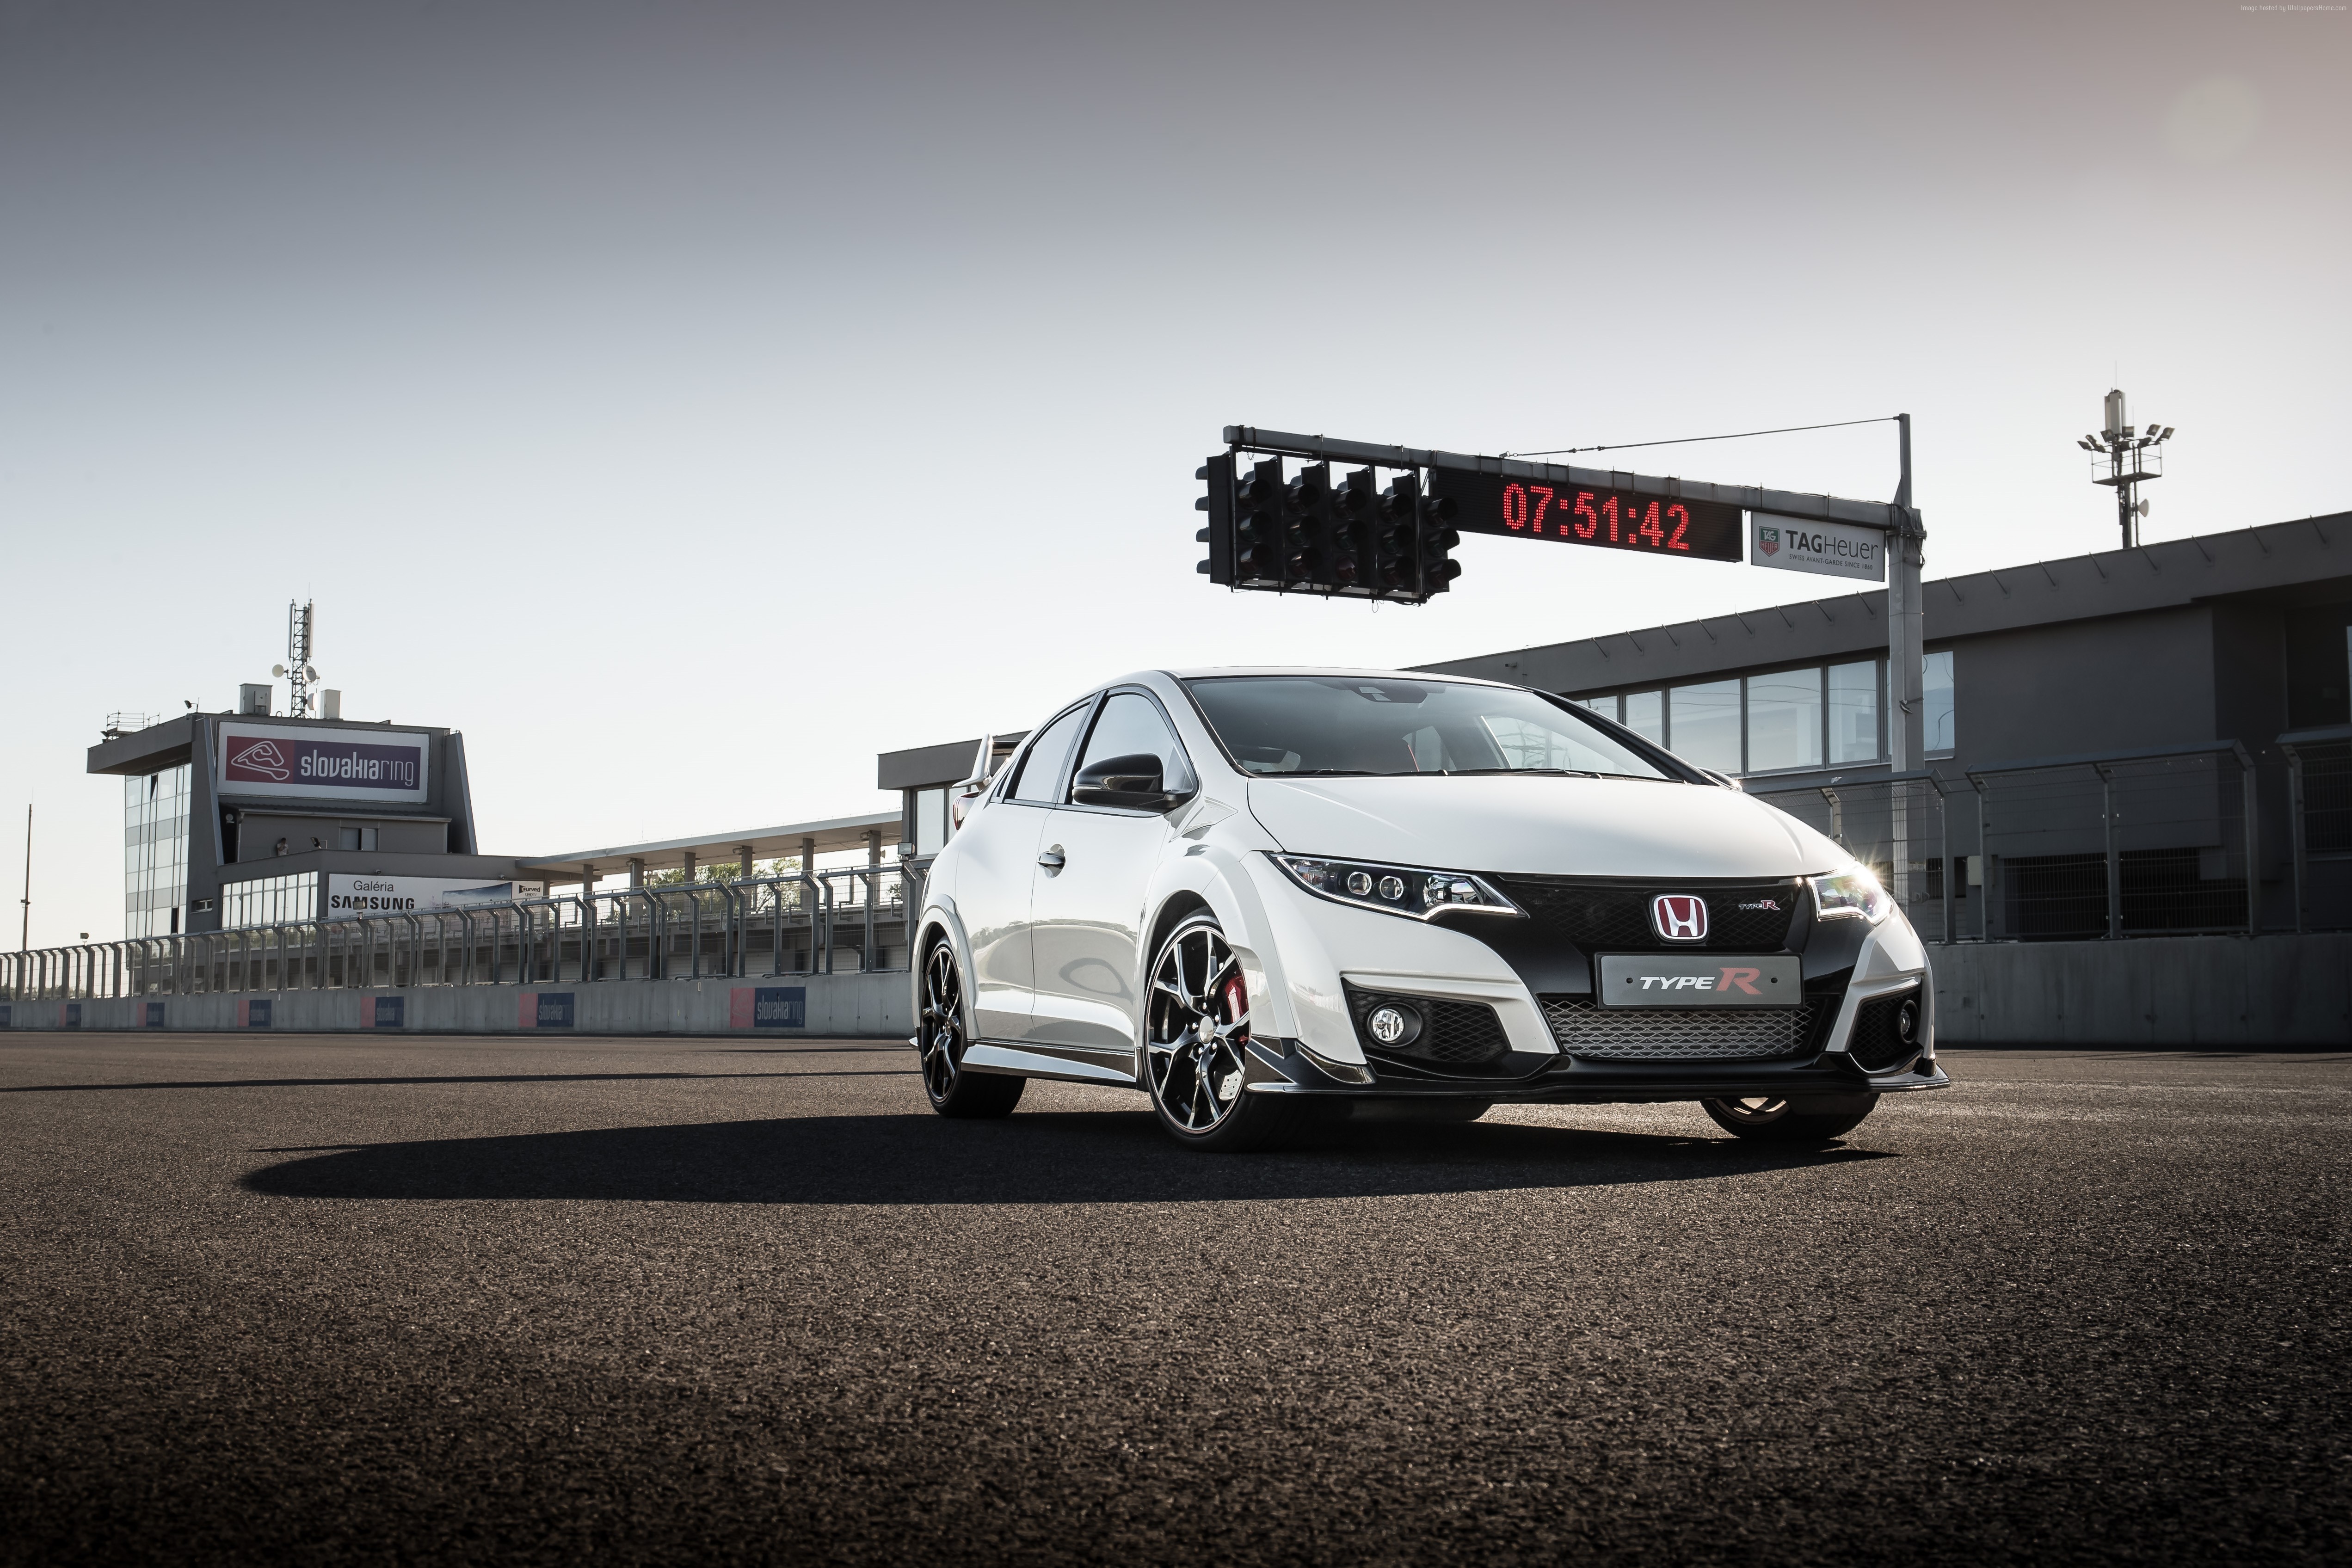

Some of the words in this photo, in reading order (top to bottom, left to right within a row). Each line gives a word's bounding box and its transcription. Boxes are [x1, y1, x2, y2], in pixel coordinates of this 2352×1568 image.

[1503, 483, 1689, 550] 07:51:42
[1763, 530, 1776, 541] TAG
[1761, 542, 1778, 553] HEUER
[1806, 556, 1843, 566] AVANT-GARDE
[353, 880, 394, 892] Galéria
[331, 895, 414, 910] SAMSUNG
